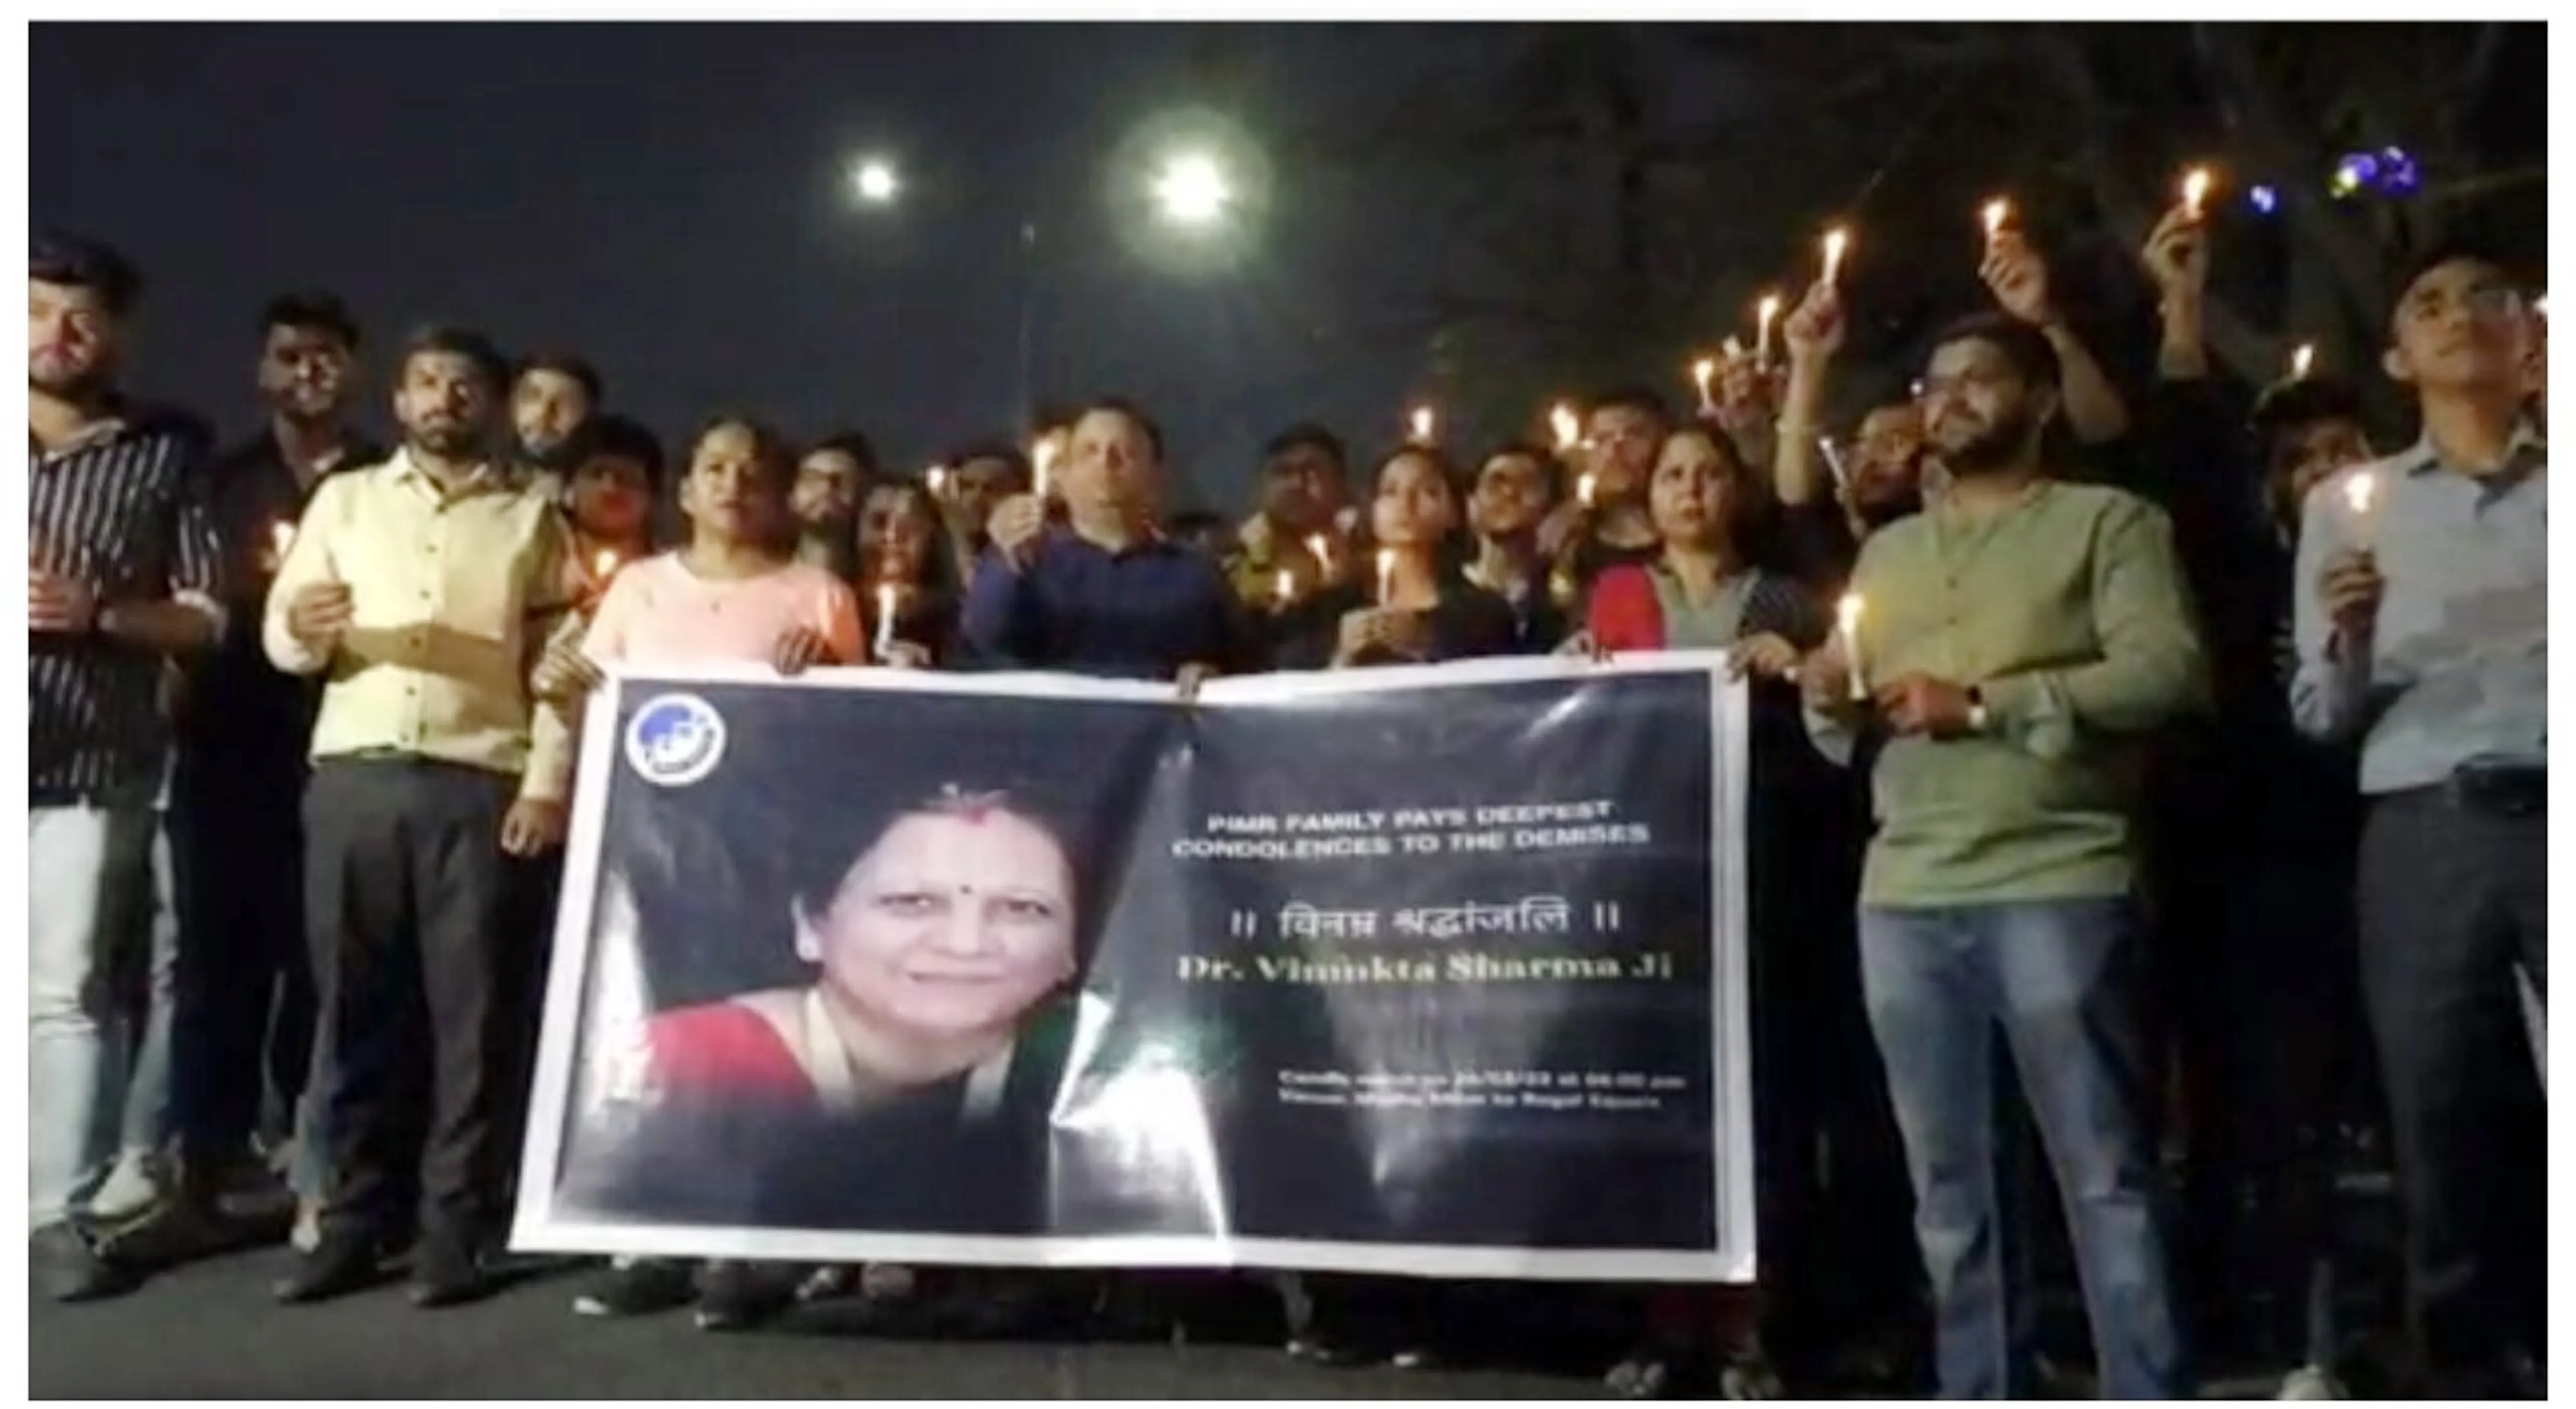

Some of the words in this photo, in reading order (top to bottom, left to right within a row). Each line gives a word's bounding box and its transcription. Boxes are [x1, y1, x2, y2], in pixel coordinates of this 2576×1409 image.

[1207, 811, 1278, 833] PIMR
[1285, 810, 1385, 832] FAMILY
[1393, 807, 1467, 829] PAYS
[1476, 800, 1613, 825] DEEPEST
[1171, 837, 1392, 860] CONDOLENCES
[1404, 832, 1441, 854] TO
[1450, 830, 1506, 852] THE
[1514, 824, 1649, 848] DEMISES
[1177, 954, 1245, 982] Dr.
[1447, 952, 1622, 982] Sharma
